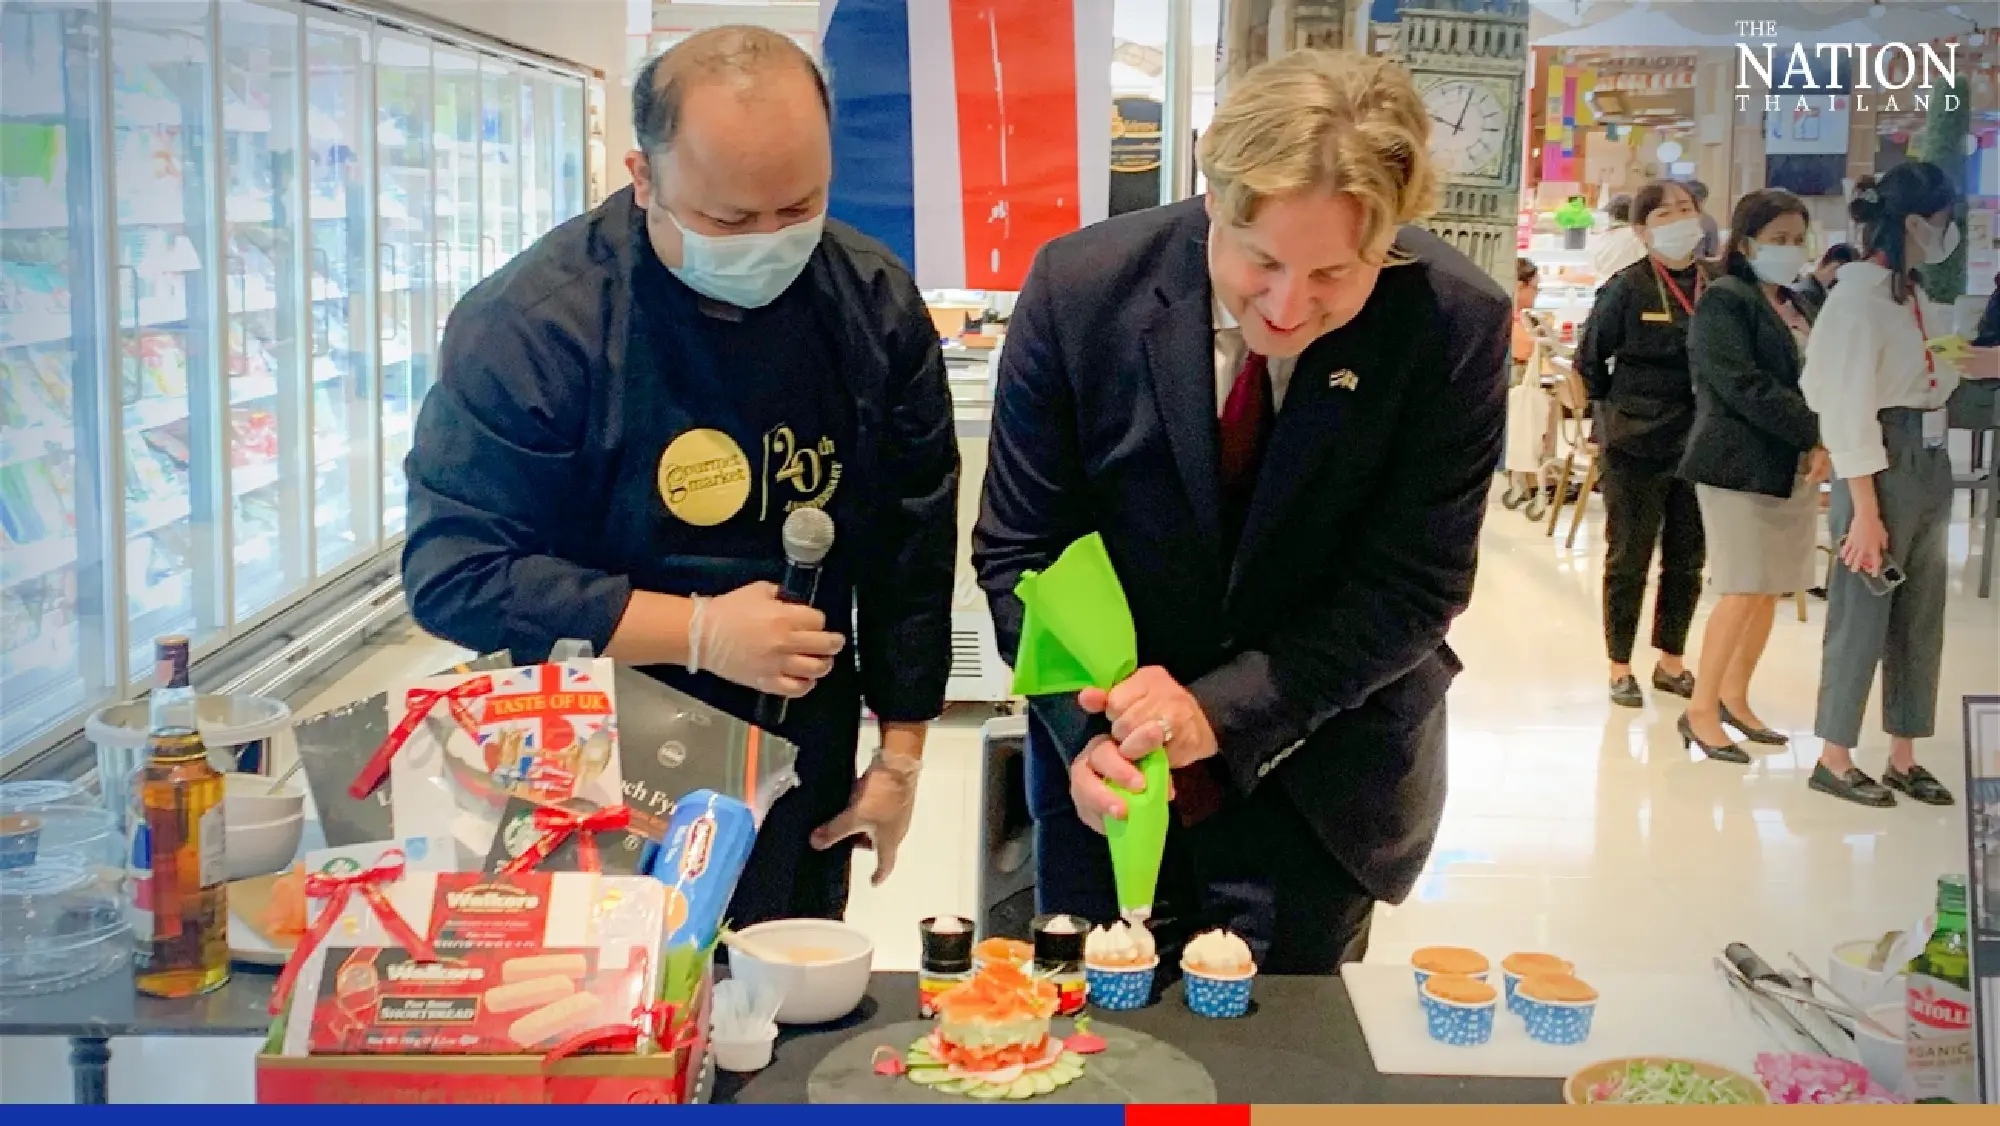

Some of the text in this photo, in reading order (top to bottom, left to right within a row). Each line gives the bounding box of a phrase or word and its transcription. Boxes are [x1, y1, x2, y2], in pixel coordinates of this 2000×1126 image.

[689, 468, 746, 492] market
[493, 693, 605, 715] TASTE OF UK
[446, 891, 539, 909] Walkers
[387, 963, 485, 981] Walkers
